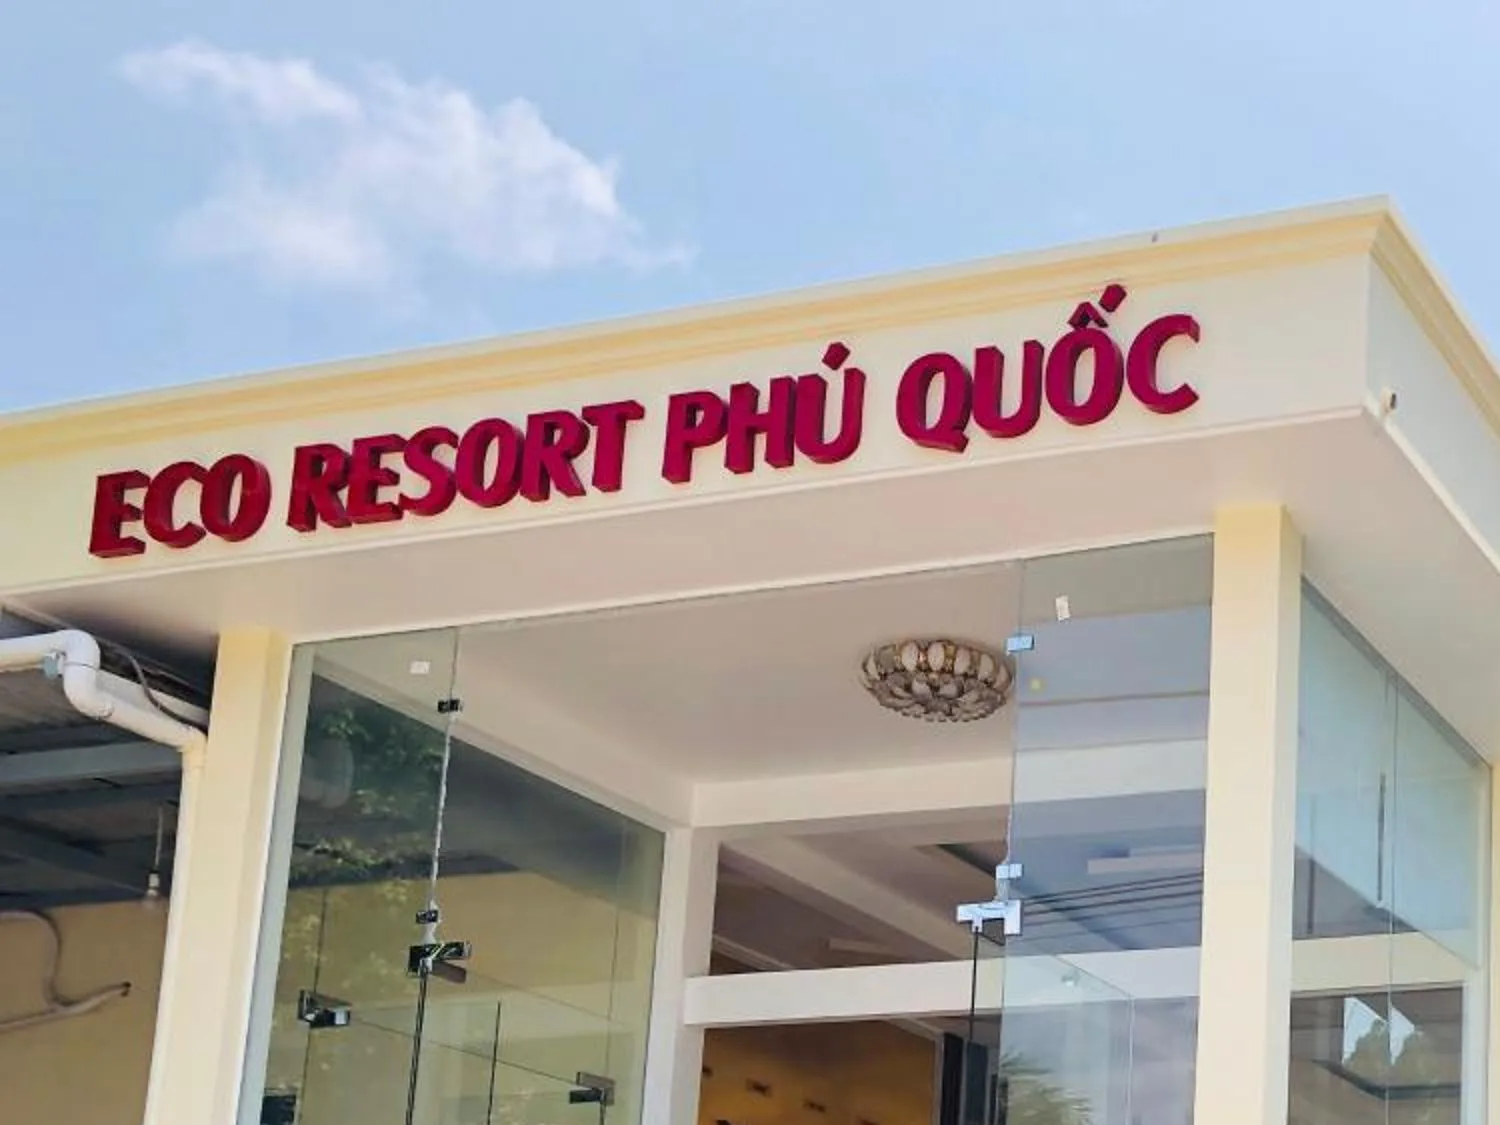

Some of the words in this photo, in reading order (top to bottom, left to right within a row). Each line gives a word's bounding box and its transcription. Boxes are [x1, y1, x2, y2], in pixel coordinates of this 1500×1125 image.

[89, 455, 271, 558] ECO
[286, 400, 645, 533] RESORT
[660, 342, 866, 484] PHÚ
[895, 283, 1201, 453] QUỐC
